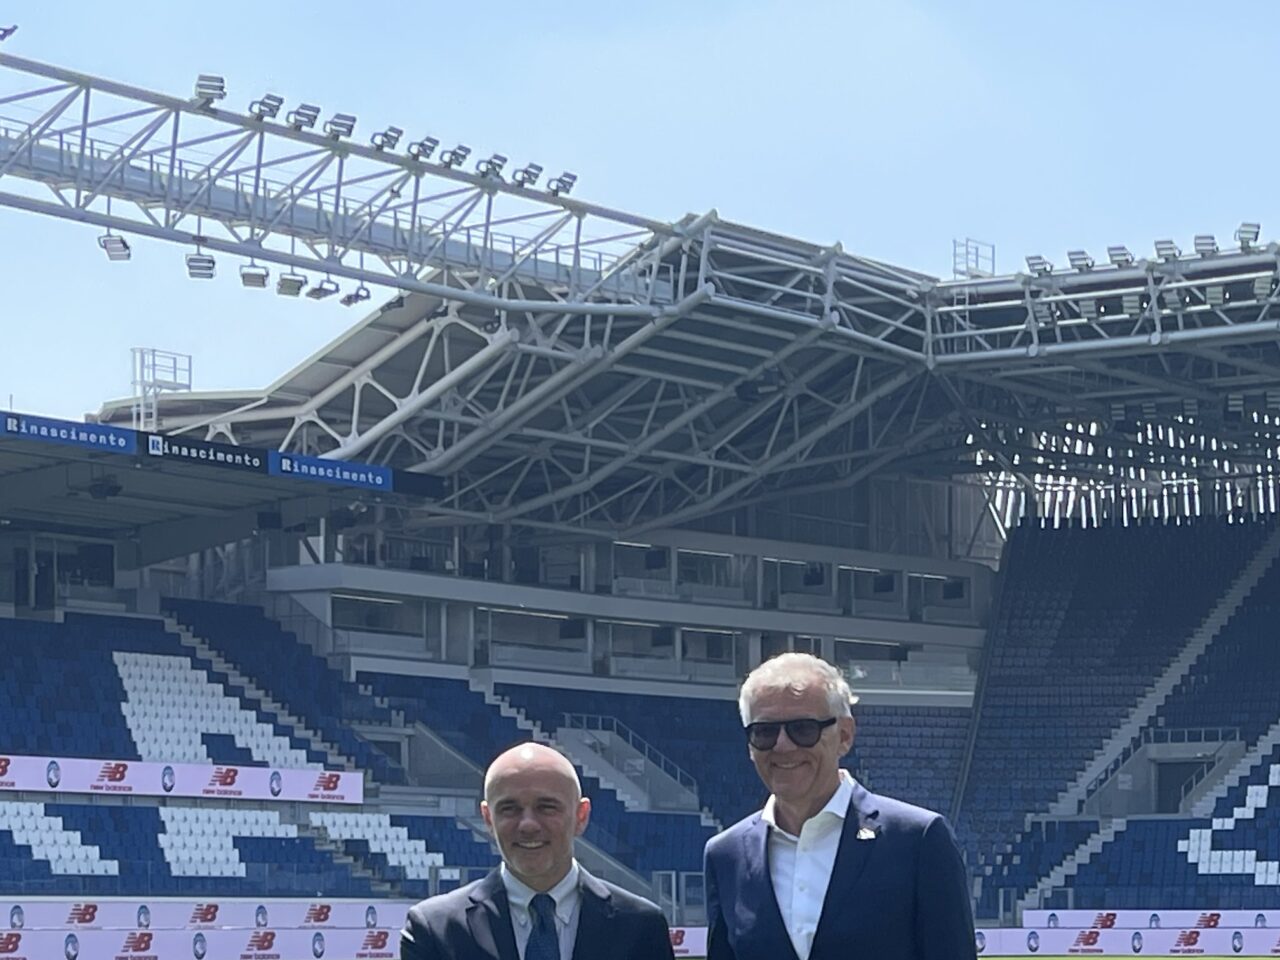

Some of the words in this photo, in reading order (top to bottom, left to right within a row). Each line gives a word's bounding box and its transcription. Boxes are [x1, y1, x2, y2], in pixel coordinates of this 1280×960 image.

[6, 417, 127, 448] Rinascimento
[149, 436, 261, 467] Rinascimento
[281, 458, 383, 485] Rinascimento
